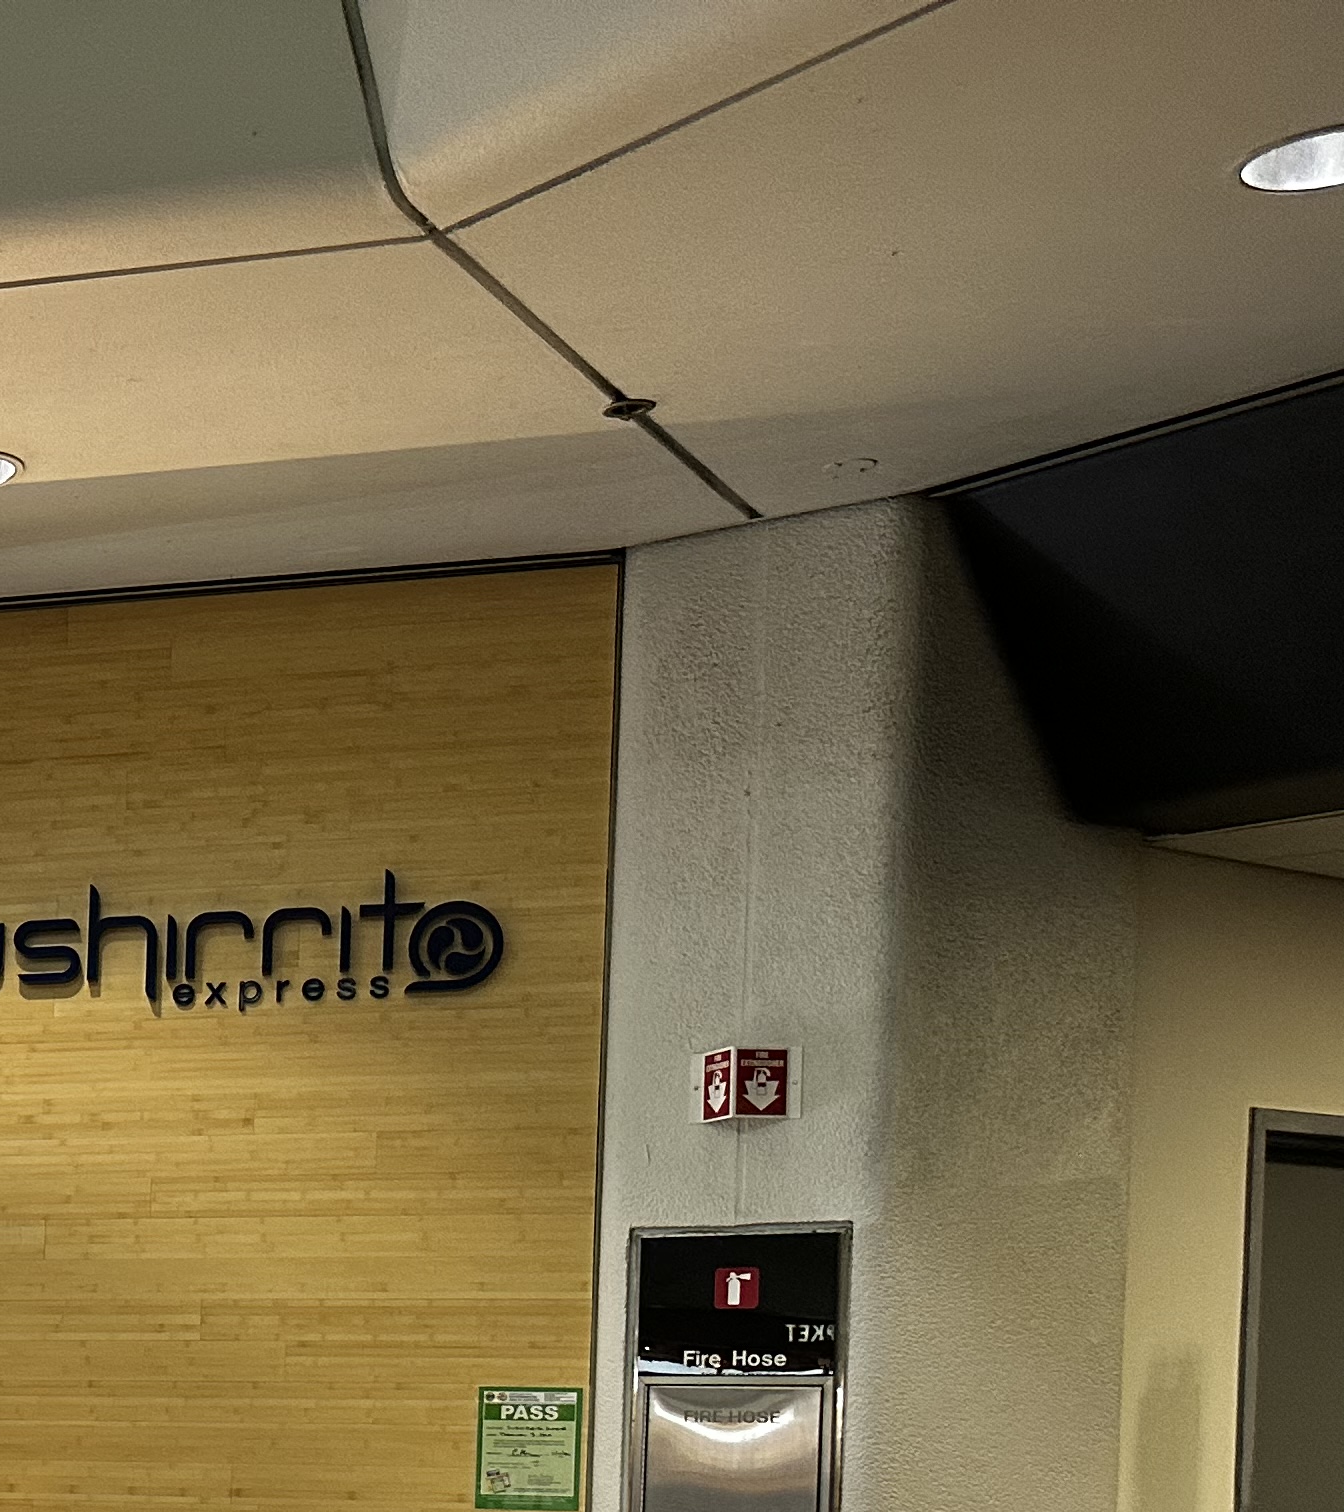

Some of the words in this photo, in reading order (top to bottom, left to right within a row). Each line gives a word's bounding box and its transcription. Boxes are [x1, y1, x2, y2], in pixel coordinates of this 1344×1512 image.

[172, 975, 391, 1013] express
[683, 1350, 721, 1367] Fire
[732, 1350, 787, 1366] Hose
[500, 1405, 559, 1420] PASS
[684, 1410, 722, 1423] FIRE
[729, 1410, 781, 1423] HOSE
